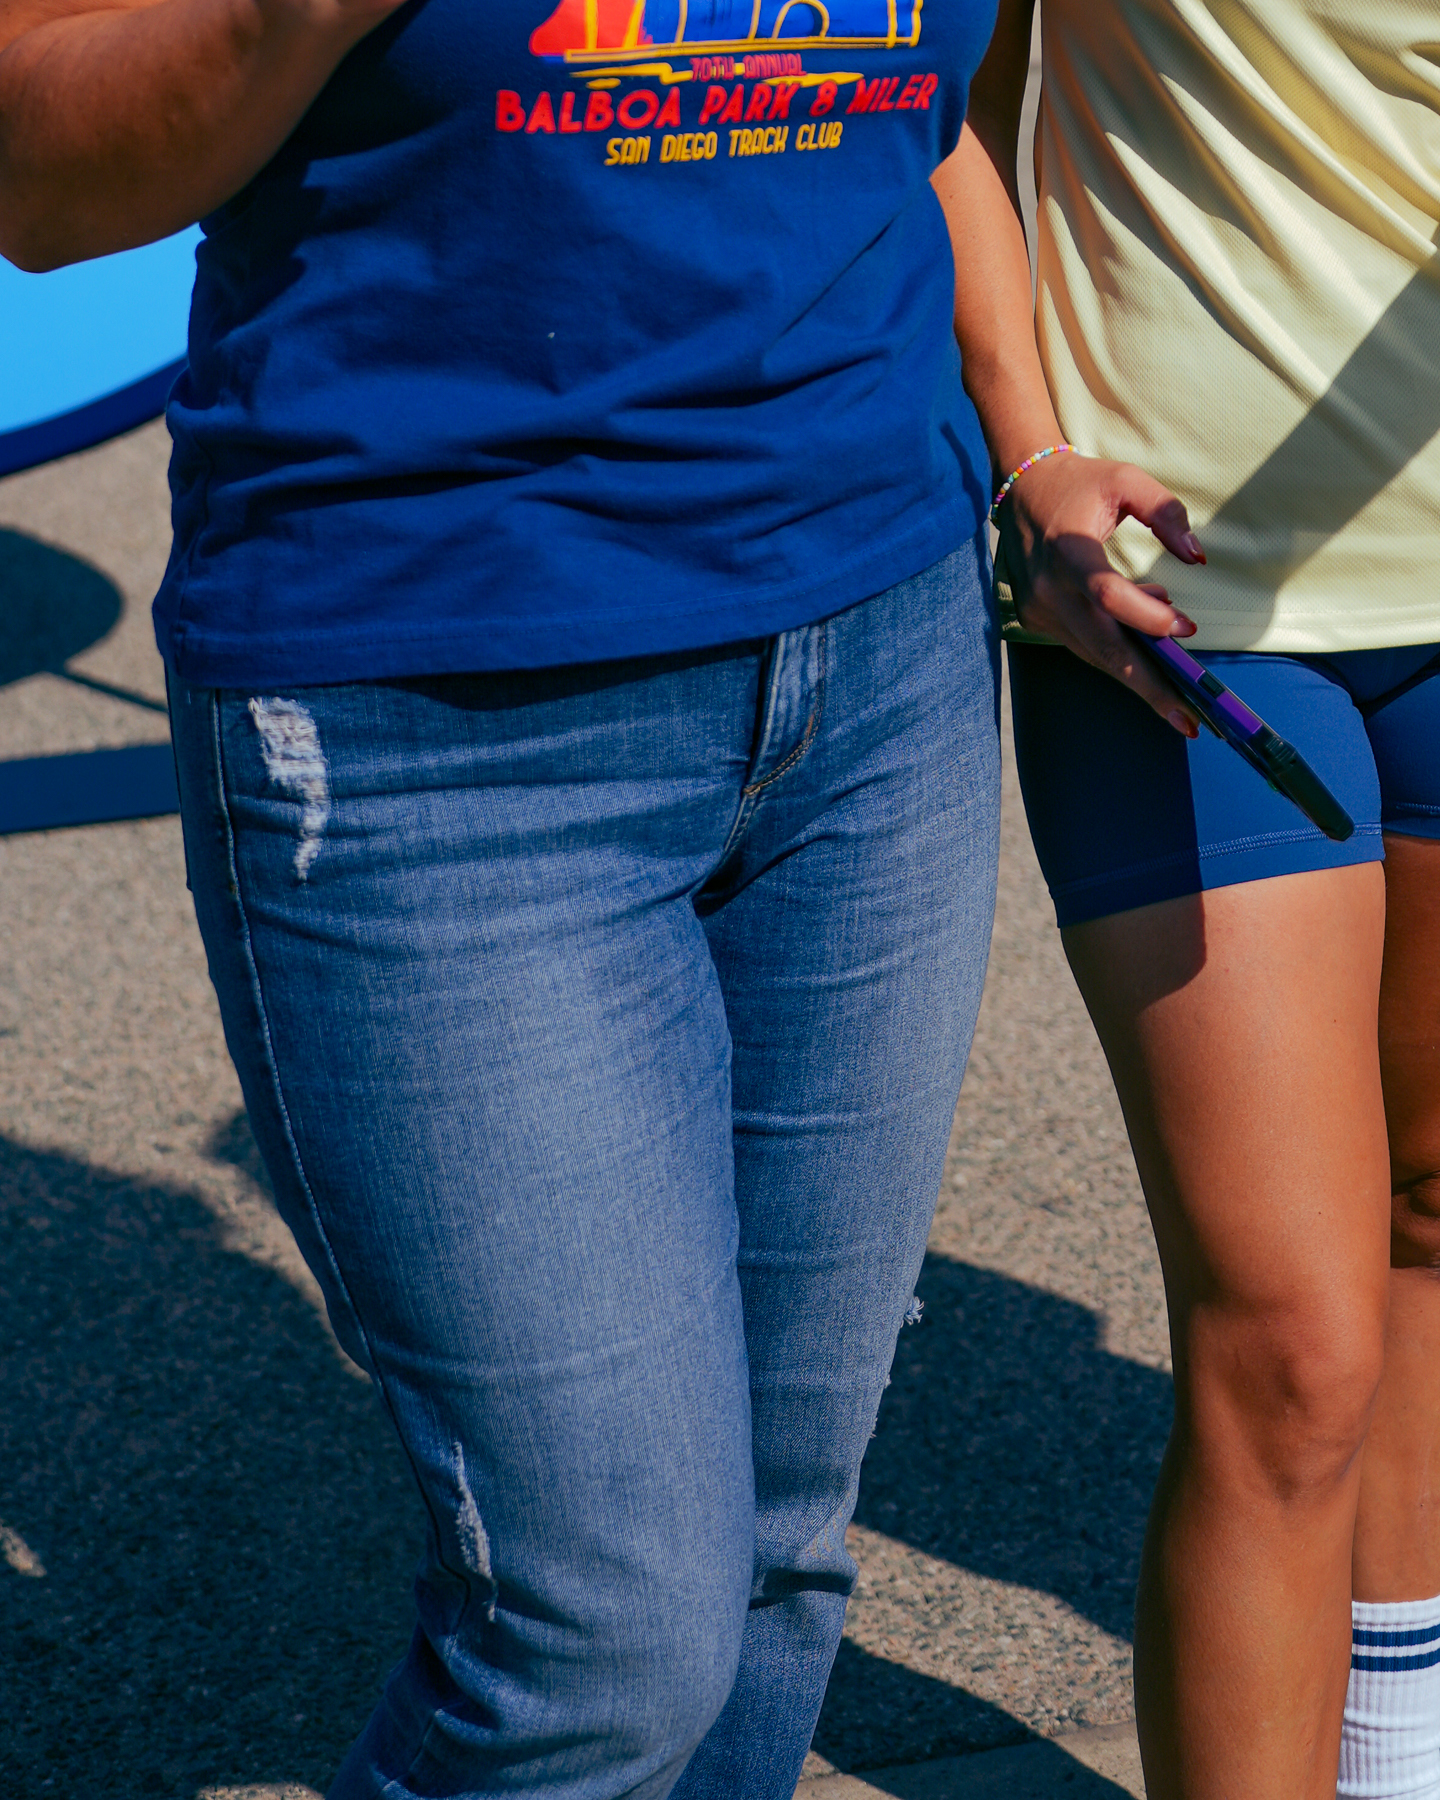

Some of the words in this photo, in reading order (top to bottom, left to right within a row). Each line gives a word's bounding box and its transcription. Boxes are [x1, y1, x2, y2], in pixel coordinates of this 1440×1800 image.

[743, 53, 807, 79] ANNUAL
[495, 86, 681, 134] BALBOA
[698, 81, 800, 125] PARK
[809, 80, 838, 117] 8
[845, 73, 939, 115] MILER
[604, 136, 651, 166] SAN
[659, 131, 718, 163] DIEGO
[728, 126, 789, 158] TRACK
[795, 121, 843, 151] CLUB
